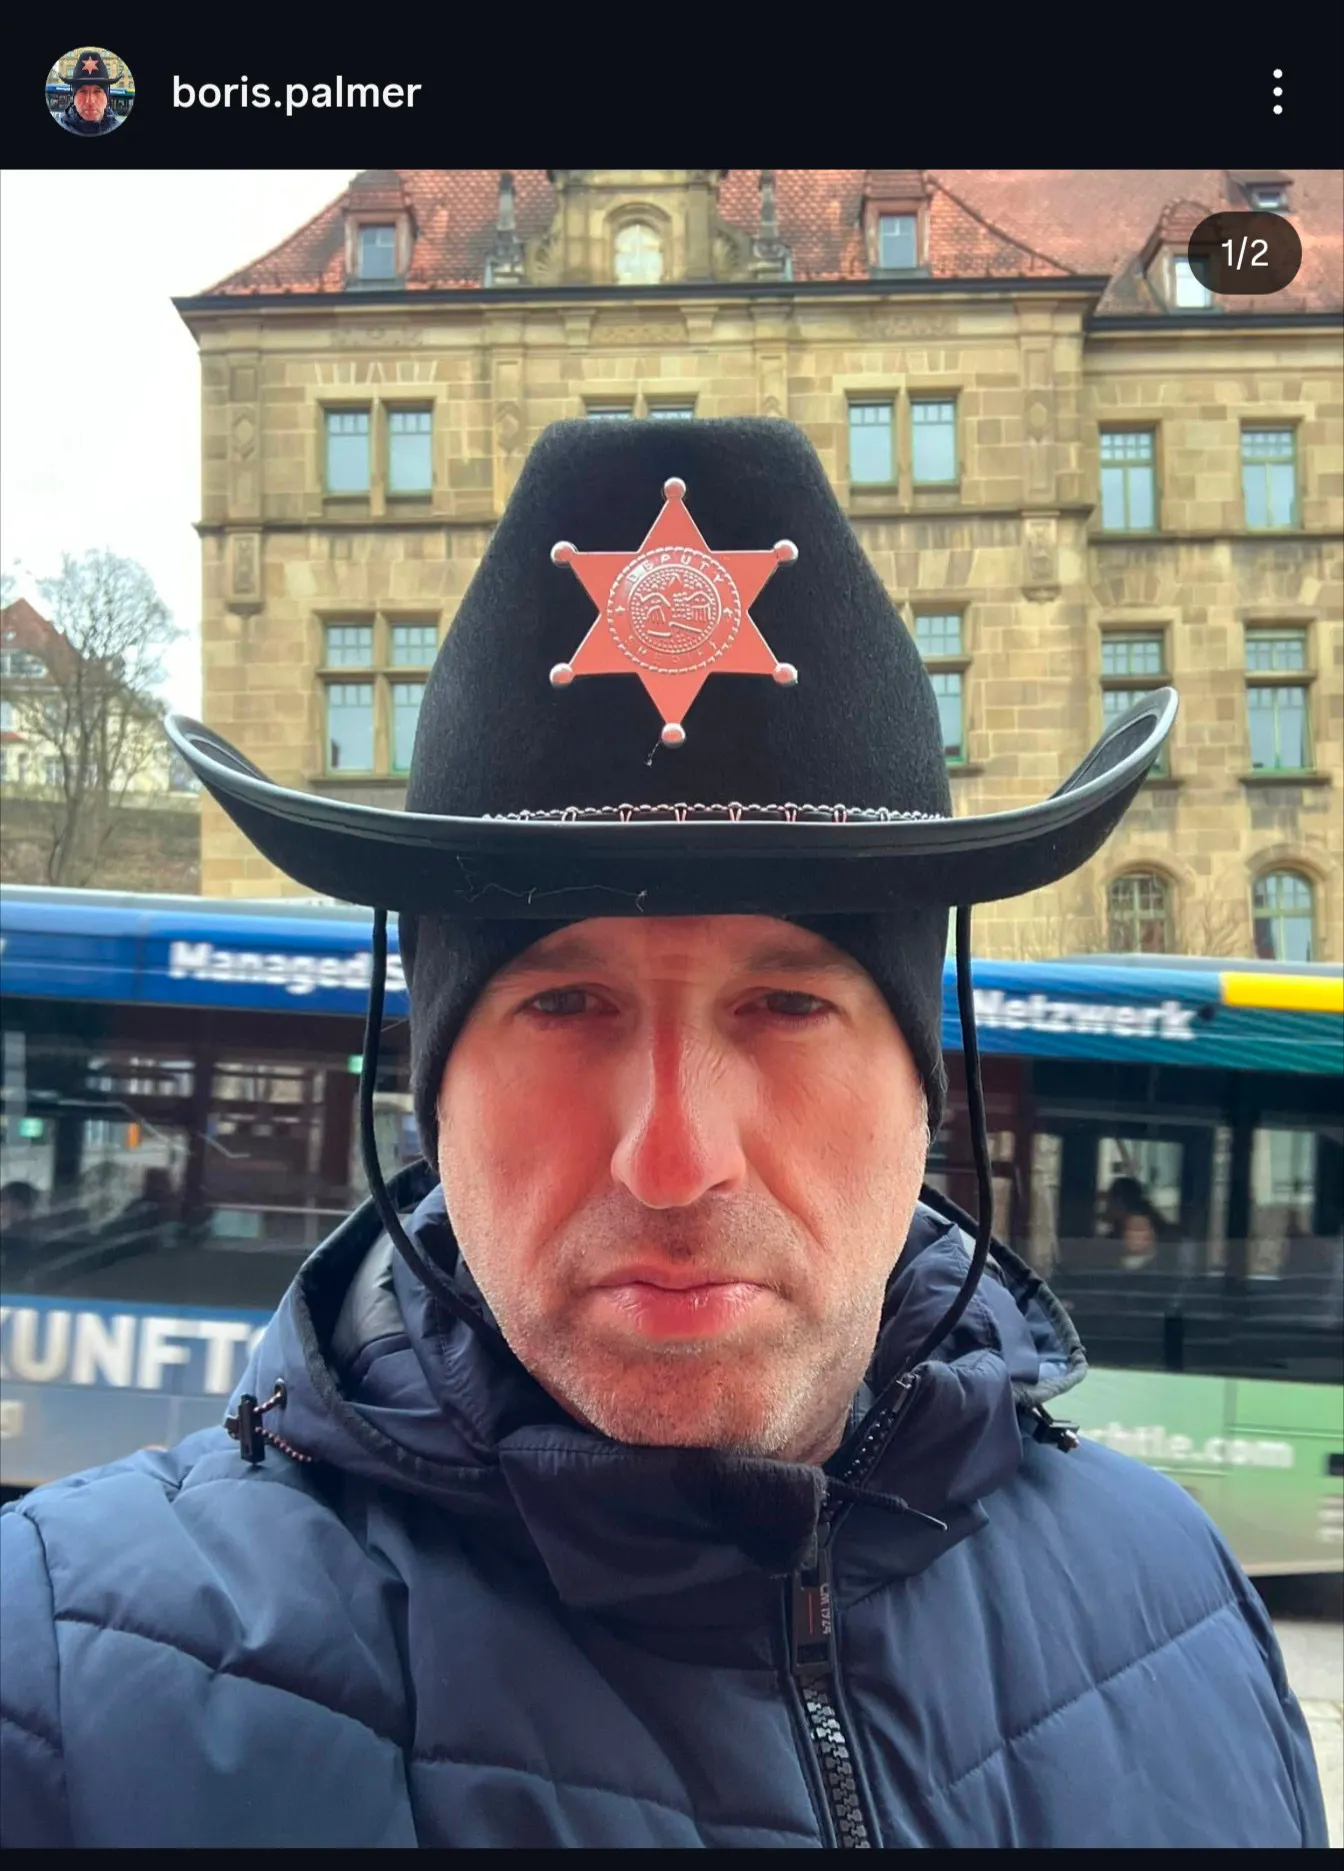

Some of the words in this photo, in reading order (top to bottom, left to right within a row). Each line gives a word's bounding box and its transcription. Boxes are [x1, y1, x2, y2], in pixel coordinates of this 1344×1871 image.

[627, 553, 725, 583] DEPUTY
[168, 940, 374, 996] Managed
[972, 988, 1198, 1041] Netzwerk
